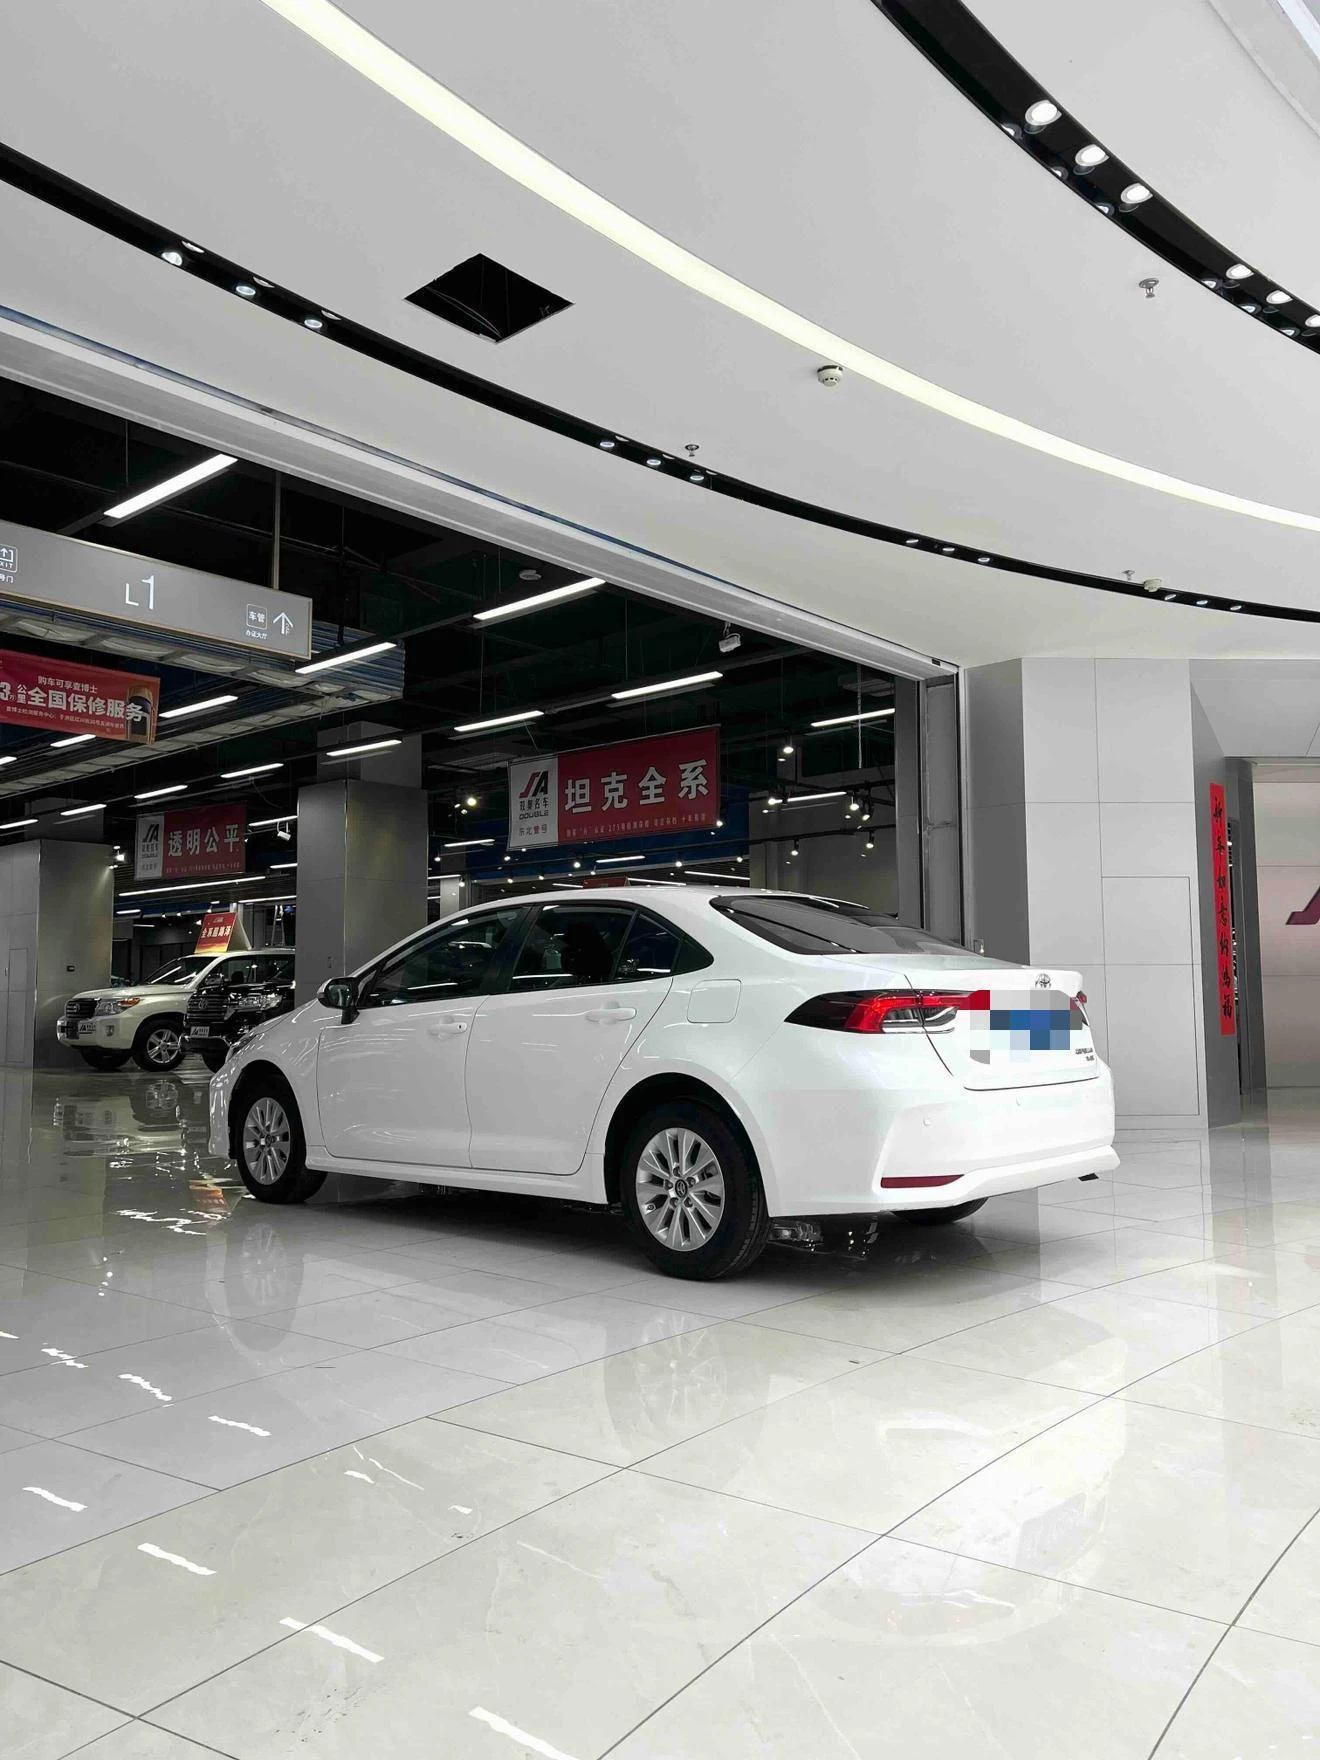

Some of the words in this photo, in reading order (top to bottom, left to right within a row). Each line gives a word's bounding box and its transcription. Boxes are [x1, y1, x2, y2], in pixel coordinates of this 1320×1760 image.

[124, 574, 155, 610] L1
[248, 611, 265, 623] 车管
[564, 758, 709, 814] 坦克全系
[168, 824, 240, 857] 透明公平
